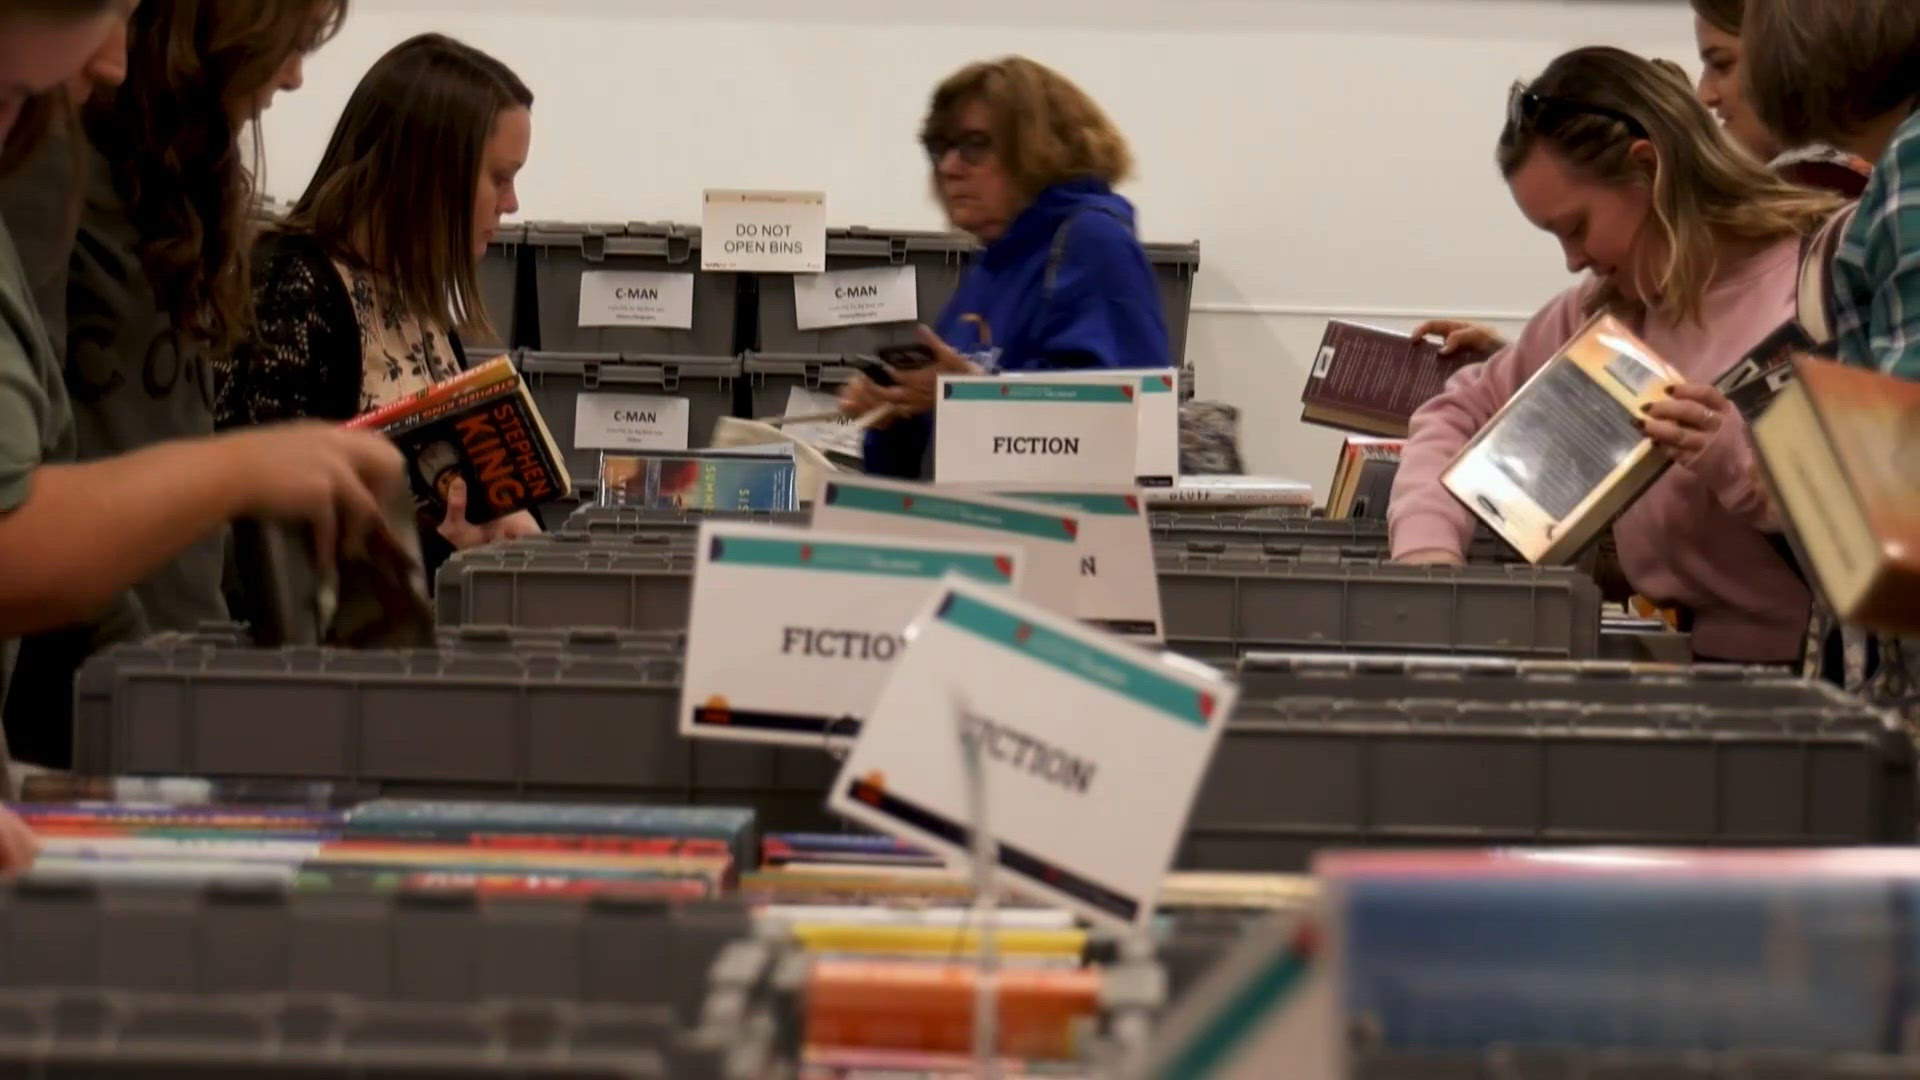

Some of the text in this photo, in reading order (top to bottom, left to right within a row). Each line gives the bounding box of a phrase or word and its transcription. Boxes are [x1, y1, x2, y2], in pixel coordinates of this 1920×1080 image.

[735, 223, 792, 237] DO NOT
[724, 240, 803, 254] OPEN BINS
[615, 287, 658, 300] C-MAN
[834, 285, 878, 299] C-MAN
[613, 410, 657, 423] C-MAN
[494, 403, 551, 499] STEPHEN
[992, 436, 1080, 455] FICTION
[454, 412, 526, 507] KING
[782, 626, 907, 662] FICTIO
